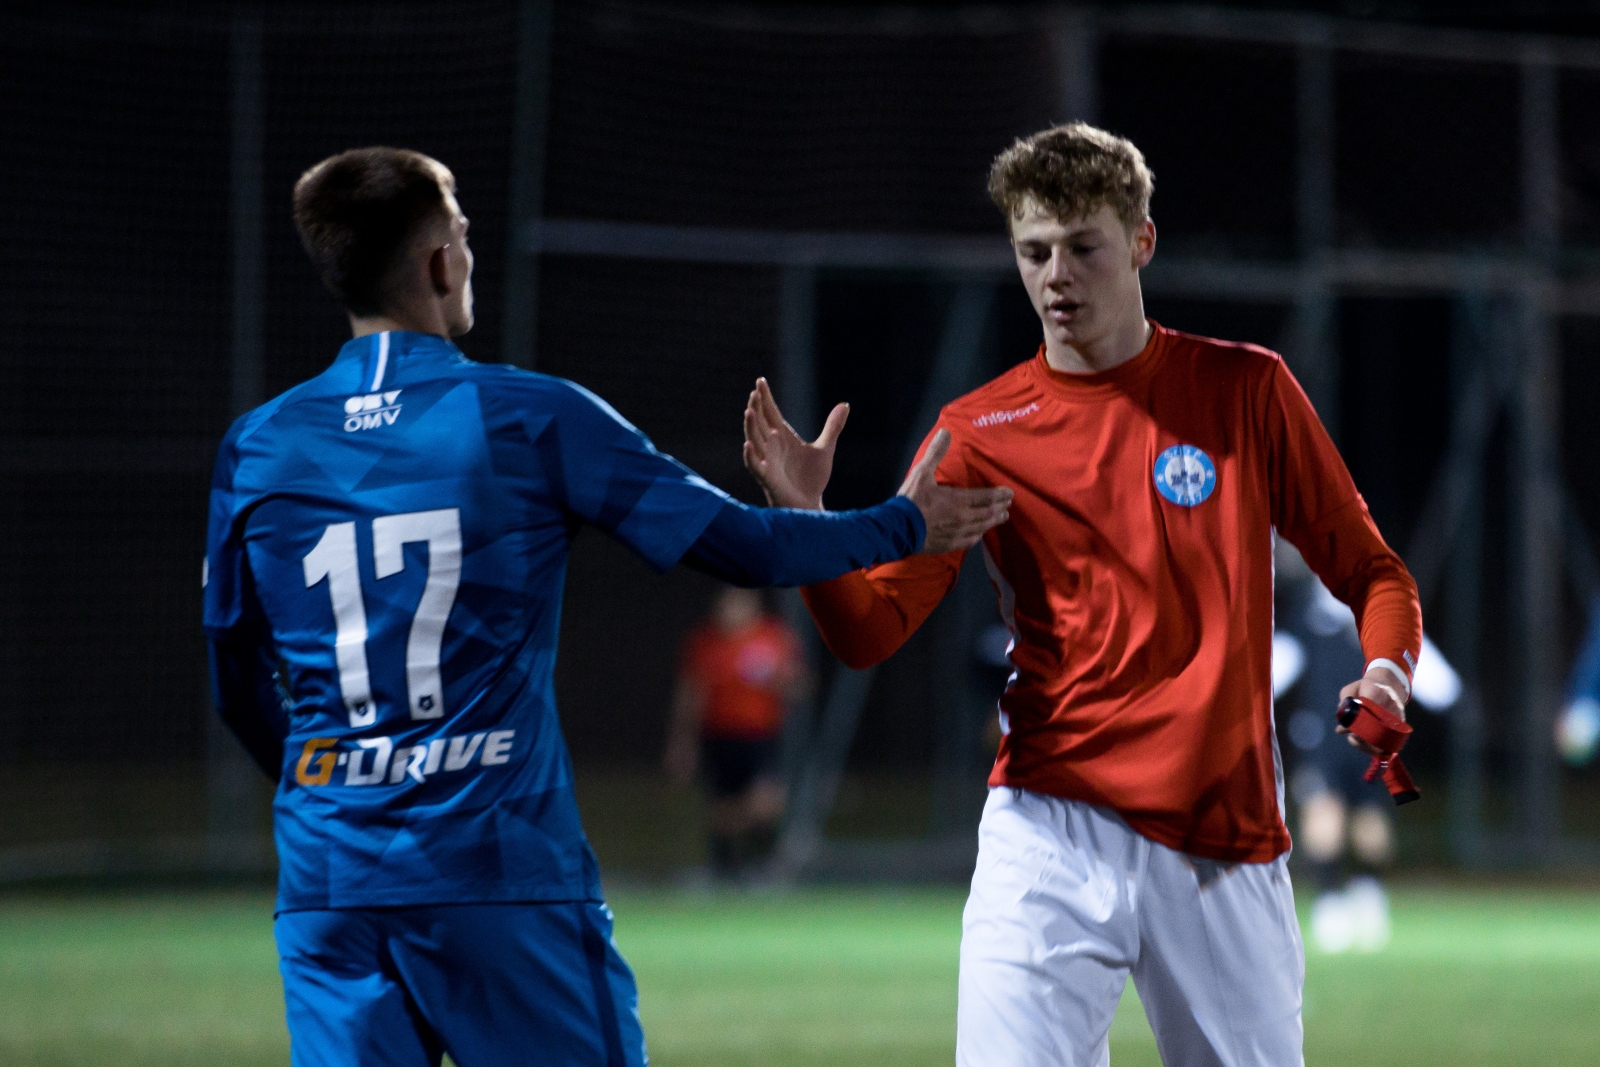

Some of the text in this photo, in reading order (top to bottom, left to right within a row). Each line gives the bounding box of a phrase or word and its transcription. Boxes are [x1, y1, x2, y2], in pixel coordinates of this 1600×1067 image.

[344, 407, 402, 433] OMV
[972, 402, 1039, 428] uhlsport
[303, 508, 463, 728] 17
